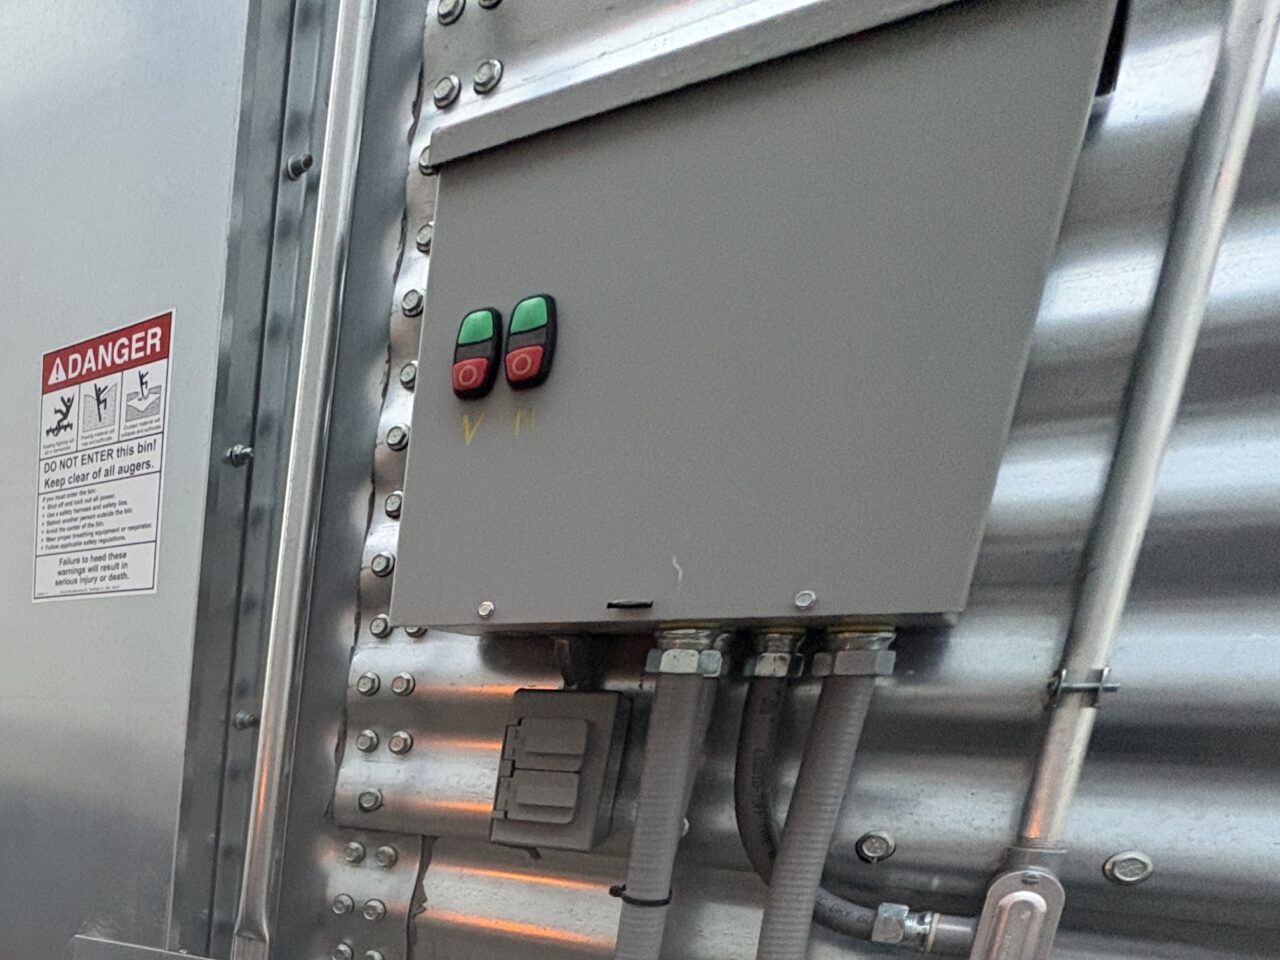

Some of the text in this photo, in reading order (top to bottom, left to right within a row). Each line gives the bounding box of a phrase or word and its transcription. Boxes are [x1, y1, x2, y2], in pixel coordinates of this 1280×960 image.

[68, 326, 162, 379] DANGER
[44, 439, 156, 473] DO NOT ENTER this bin!
[44, 460, 154, 489] Keep clear of all augers.
[80, 514, 96, 522] person
[57, 534, 72, 542] proper
[72, 531, 94, 539] breathing
[95, 527, 120, 536] equipment
[60, 540, 82, 549] applicable
[59, 551, 127, 566] Failure to heed these
[57, 565, 86, 576] warnings
[88, 563, 99, 573] will
[100, 562, 120, 572] result
[55, 572, 129, 586] serious injury or death.
